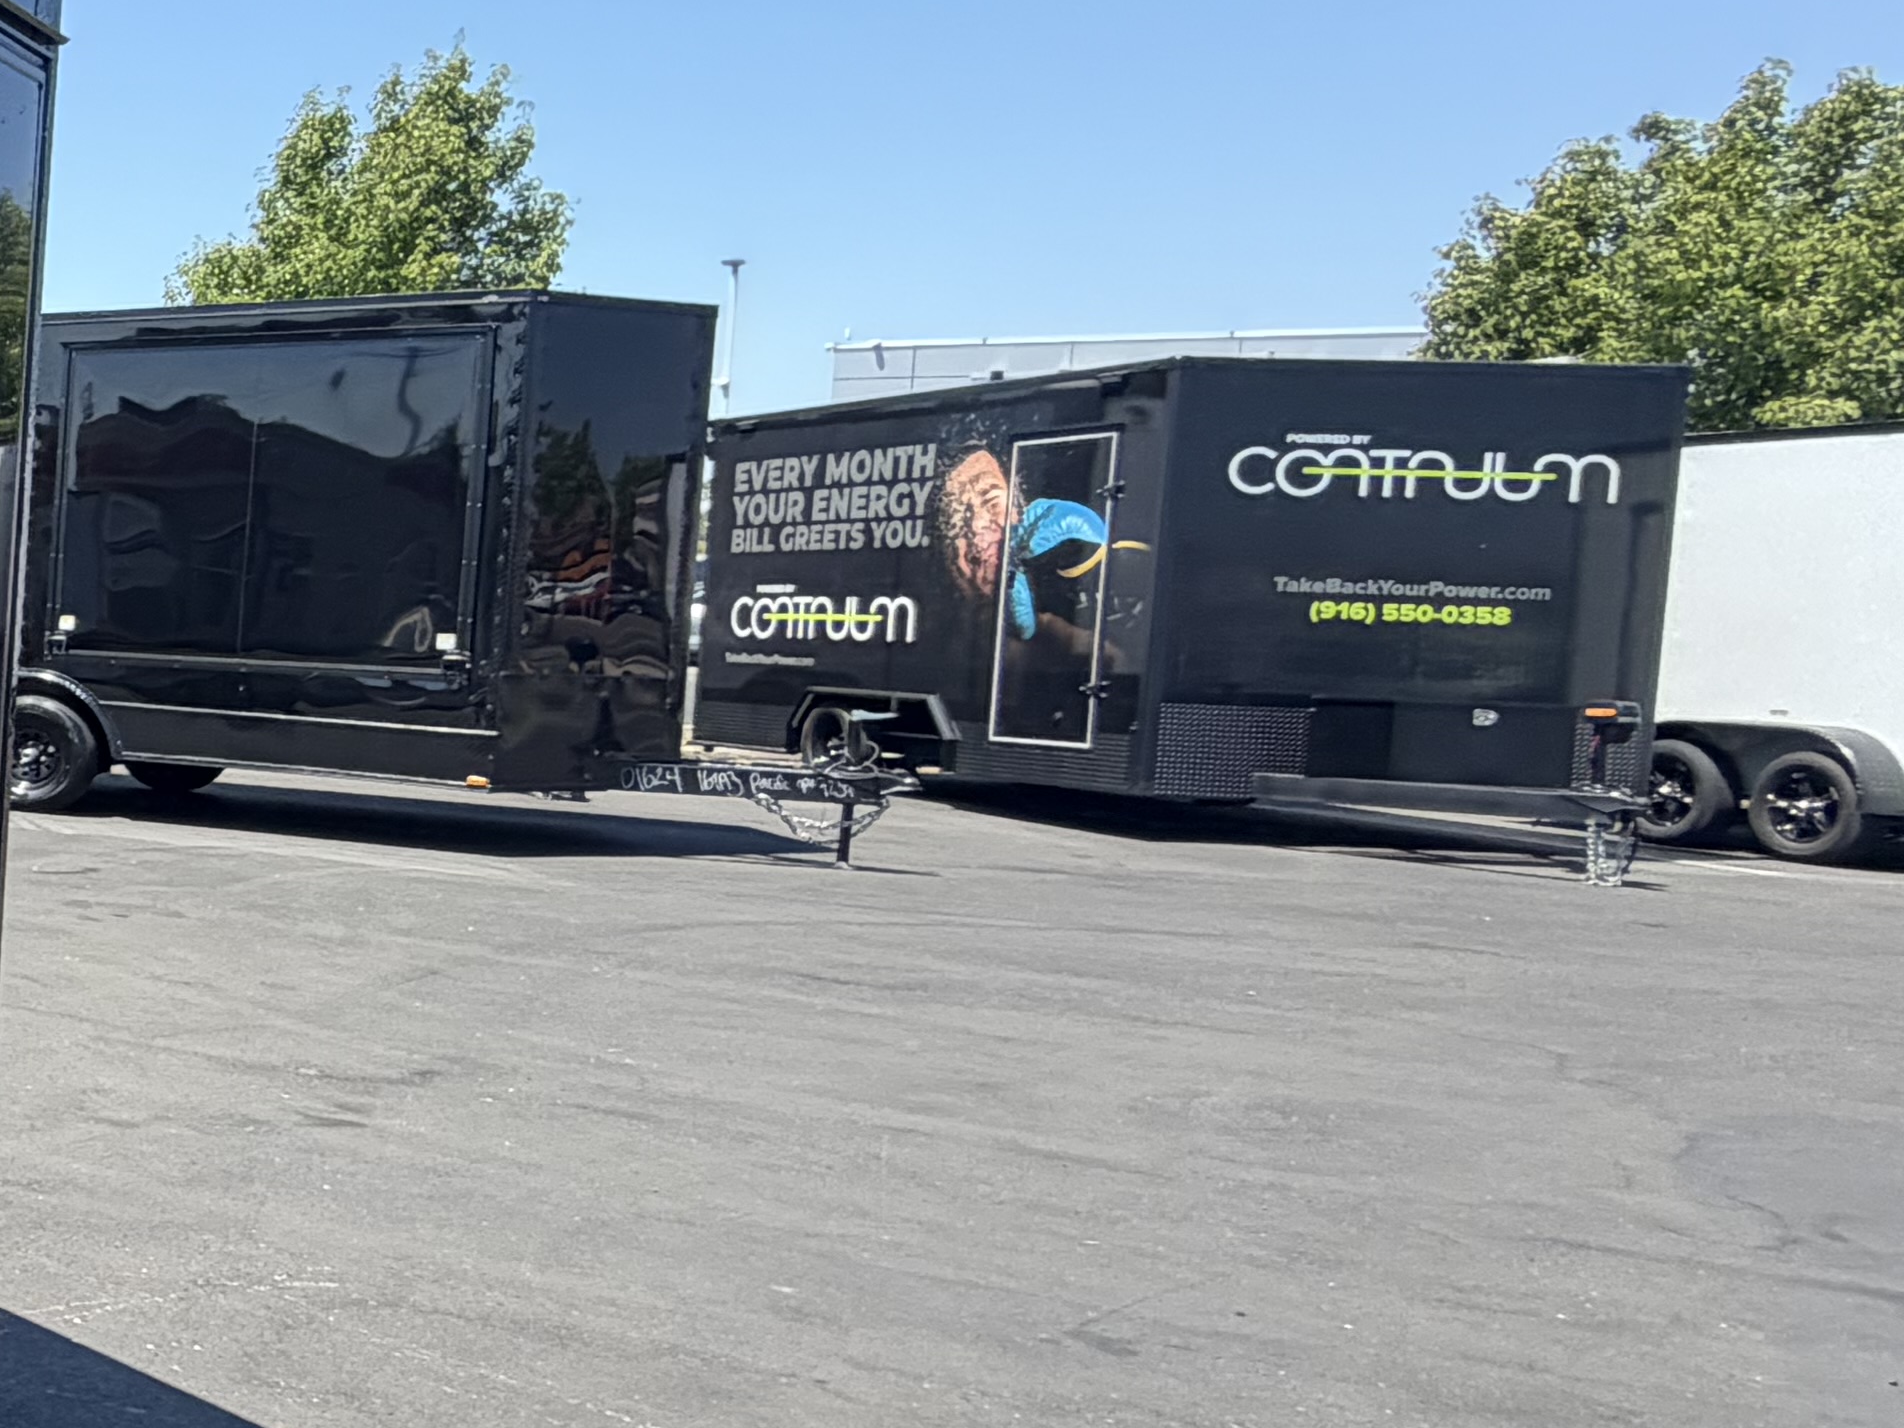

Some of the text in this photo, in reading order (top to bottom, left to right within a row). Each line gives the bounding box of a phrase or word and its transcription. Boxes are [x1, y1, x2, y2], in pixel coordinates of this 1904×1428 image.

[734, 443, 937, 492] EVERY MONTH
[732, 480, 935, 525] YOUR ENERGY
[730, 520, 931, 553] BILL GREETS YOU.
[1273, 575, 1552, 600] TakeBackYourPower.com
[1309, 600, 1512, 625] (916) 550-0358
